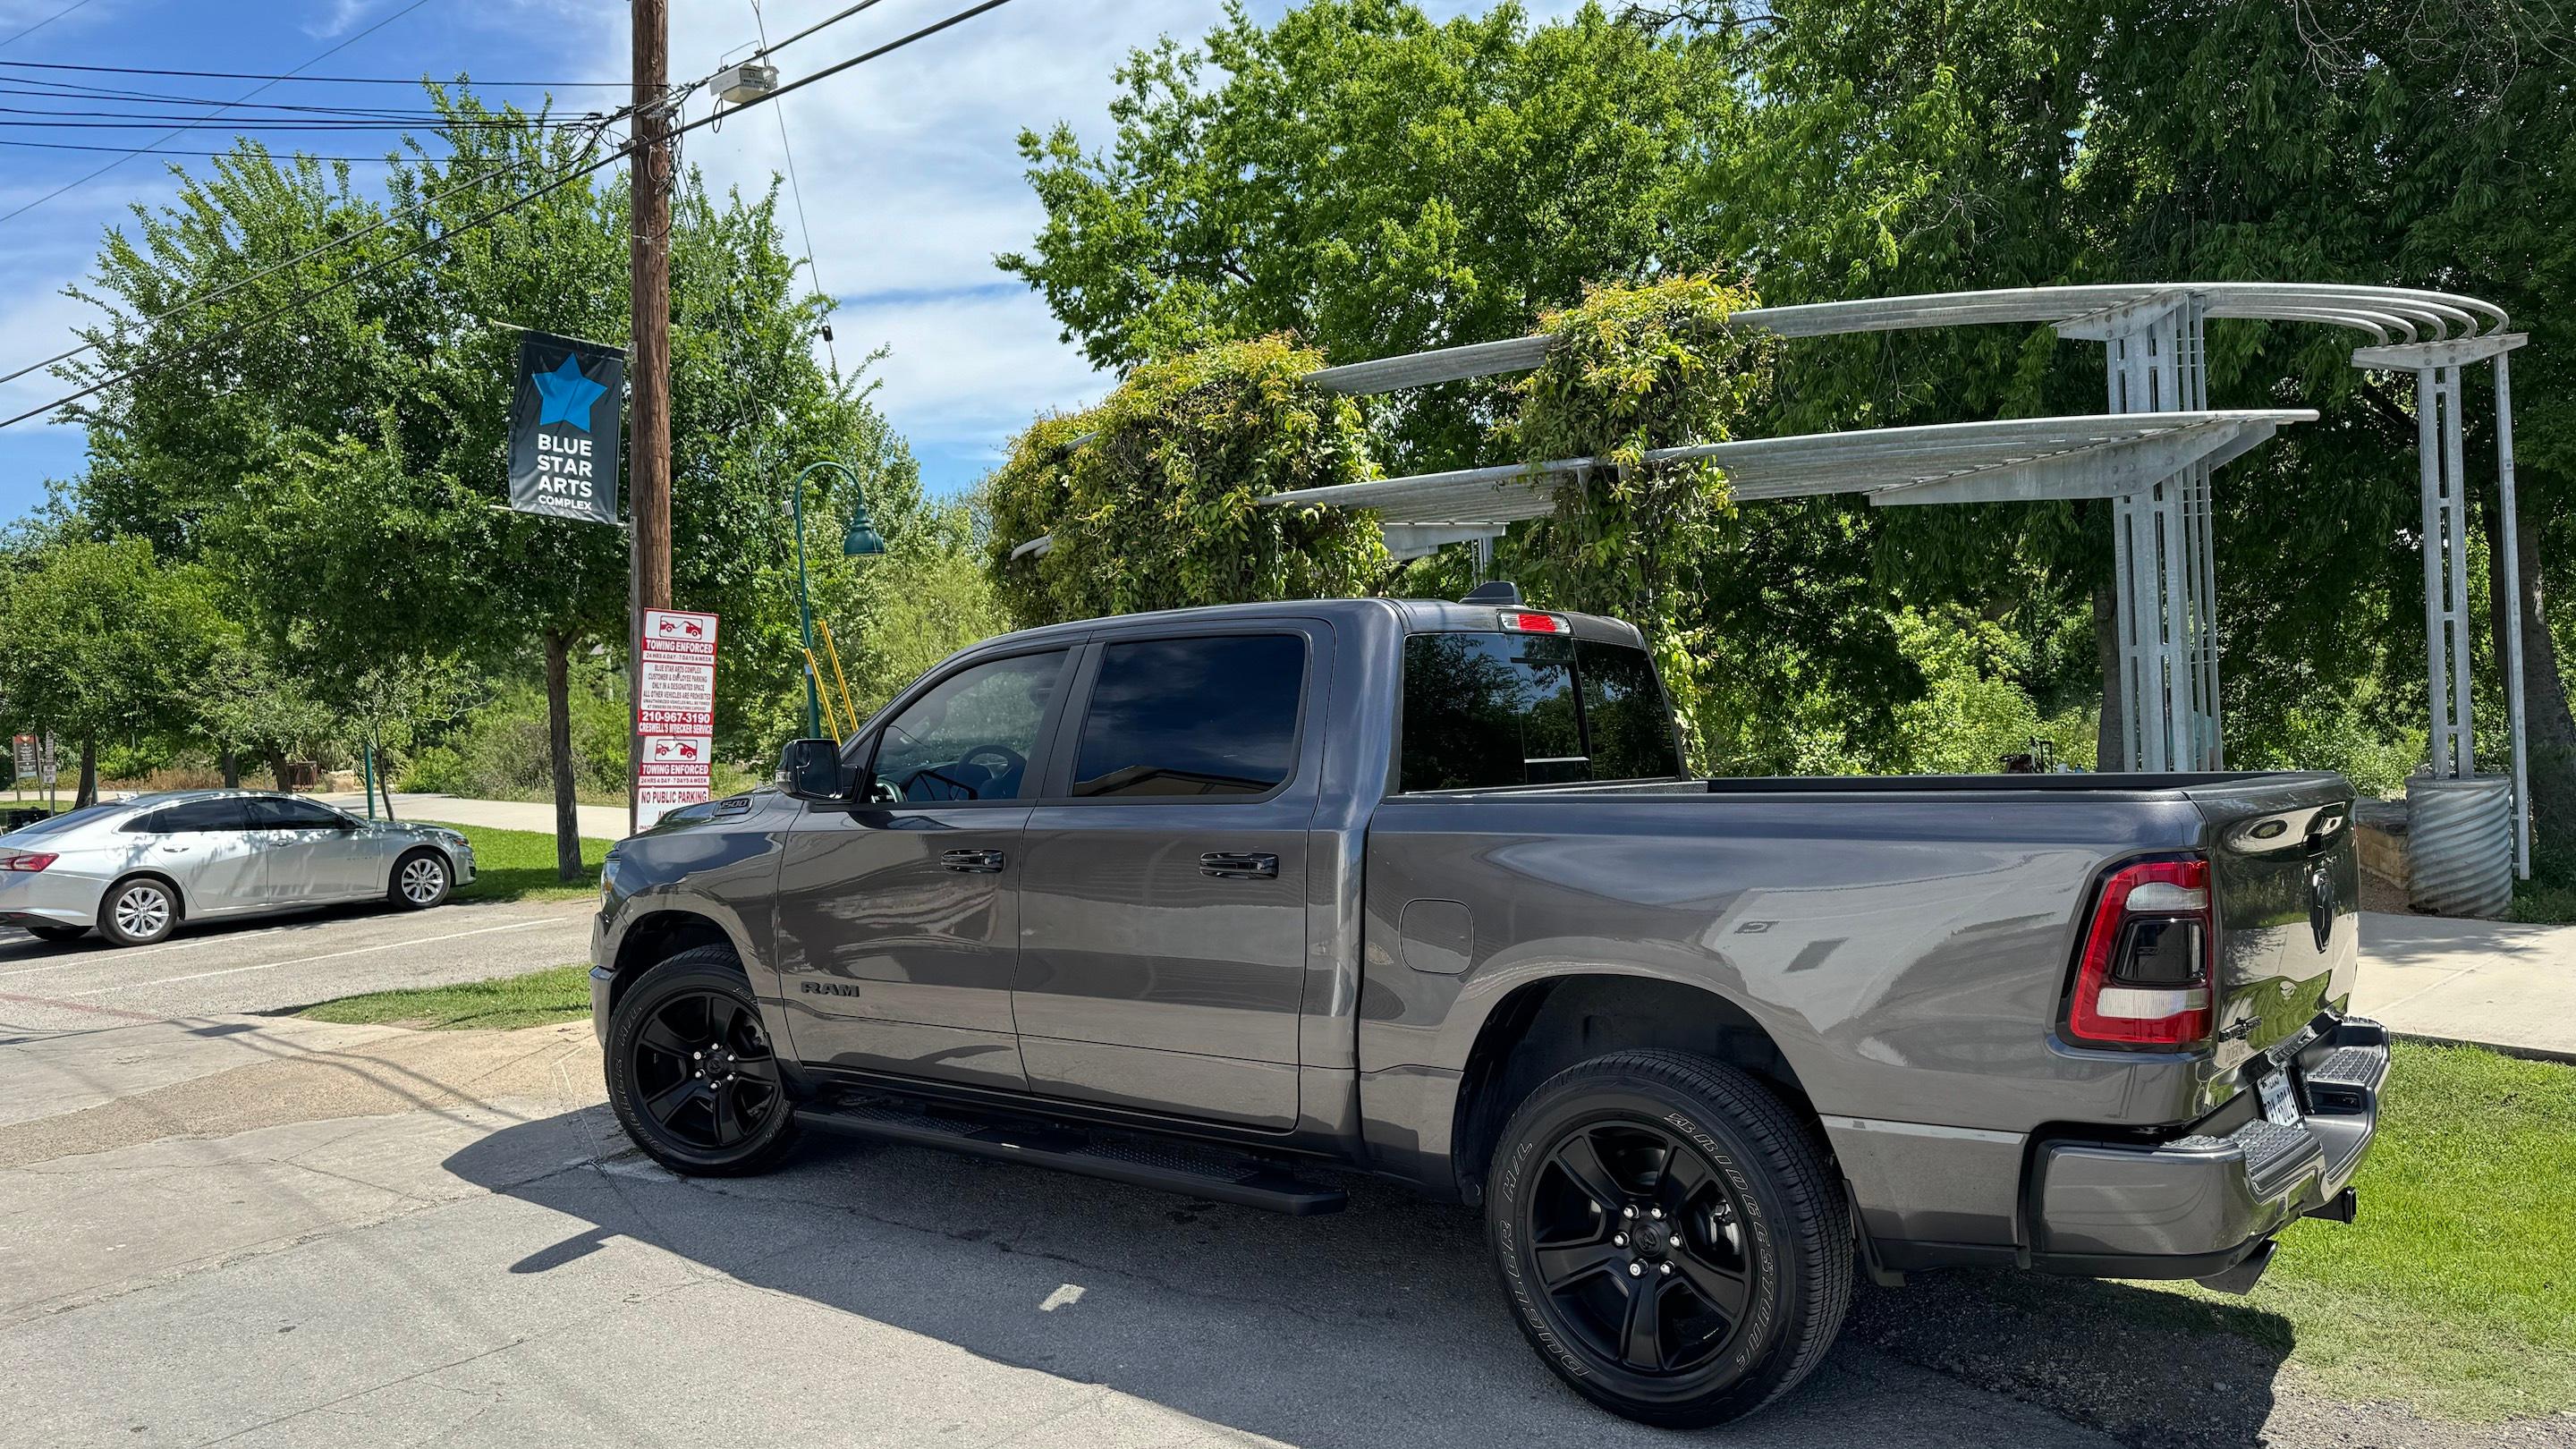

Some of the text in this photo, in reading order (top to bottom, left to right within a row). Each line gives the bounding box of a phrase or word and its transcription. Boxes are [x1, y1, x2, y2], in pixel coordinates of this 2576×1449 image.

[538, 433, 592, 456] BLUE
[538, 454, 592, 477] STAR
[538, 475, 592, 497] ARTS
[538, 495, 591, 510] COMPLEX
[646, 640, 713, 653] TOWING ENFORCED
[648, 672, 668, 680] CUSTOMER
[642, 711, 710, 723] 210-967-3190
[639, 723, 713, 733] CRESWELL'S WRECKER SERVICE
[643, 765, 708, 774] TOWING ENFORCED
[641, 791, 706, 804] NO PUBLIC PARKING
[720, 799, 748, 808] 1500
[801, 981, 860, 997] RAM
[1664, 1112, 1775, 1372] BRIDGESTONE
[1500, 1142, 1590, 1377] DUELER H/L
